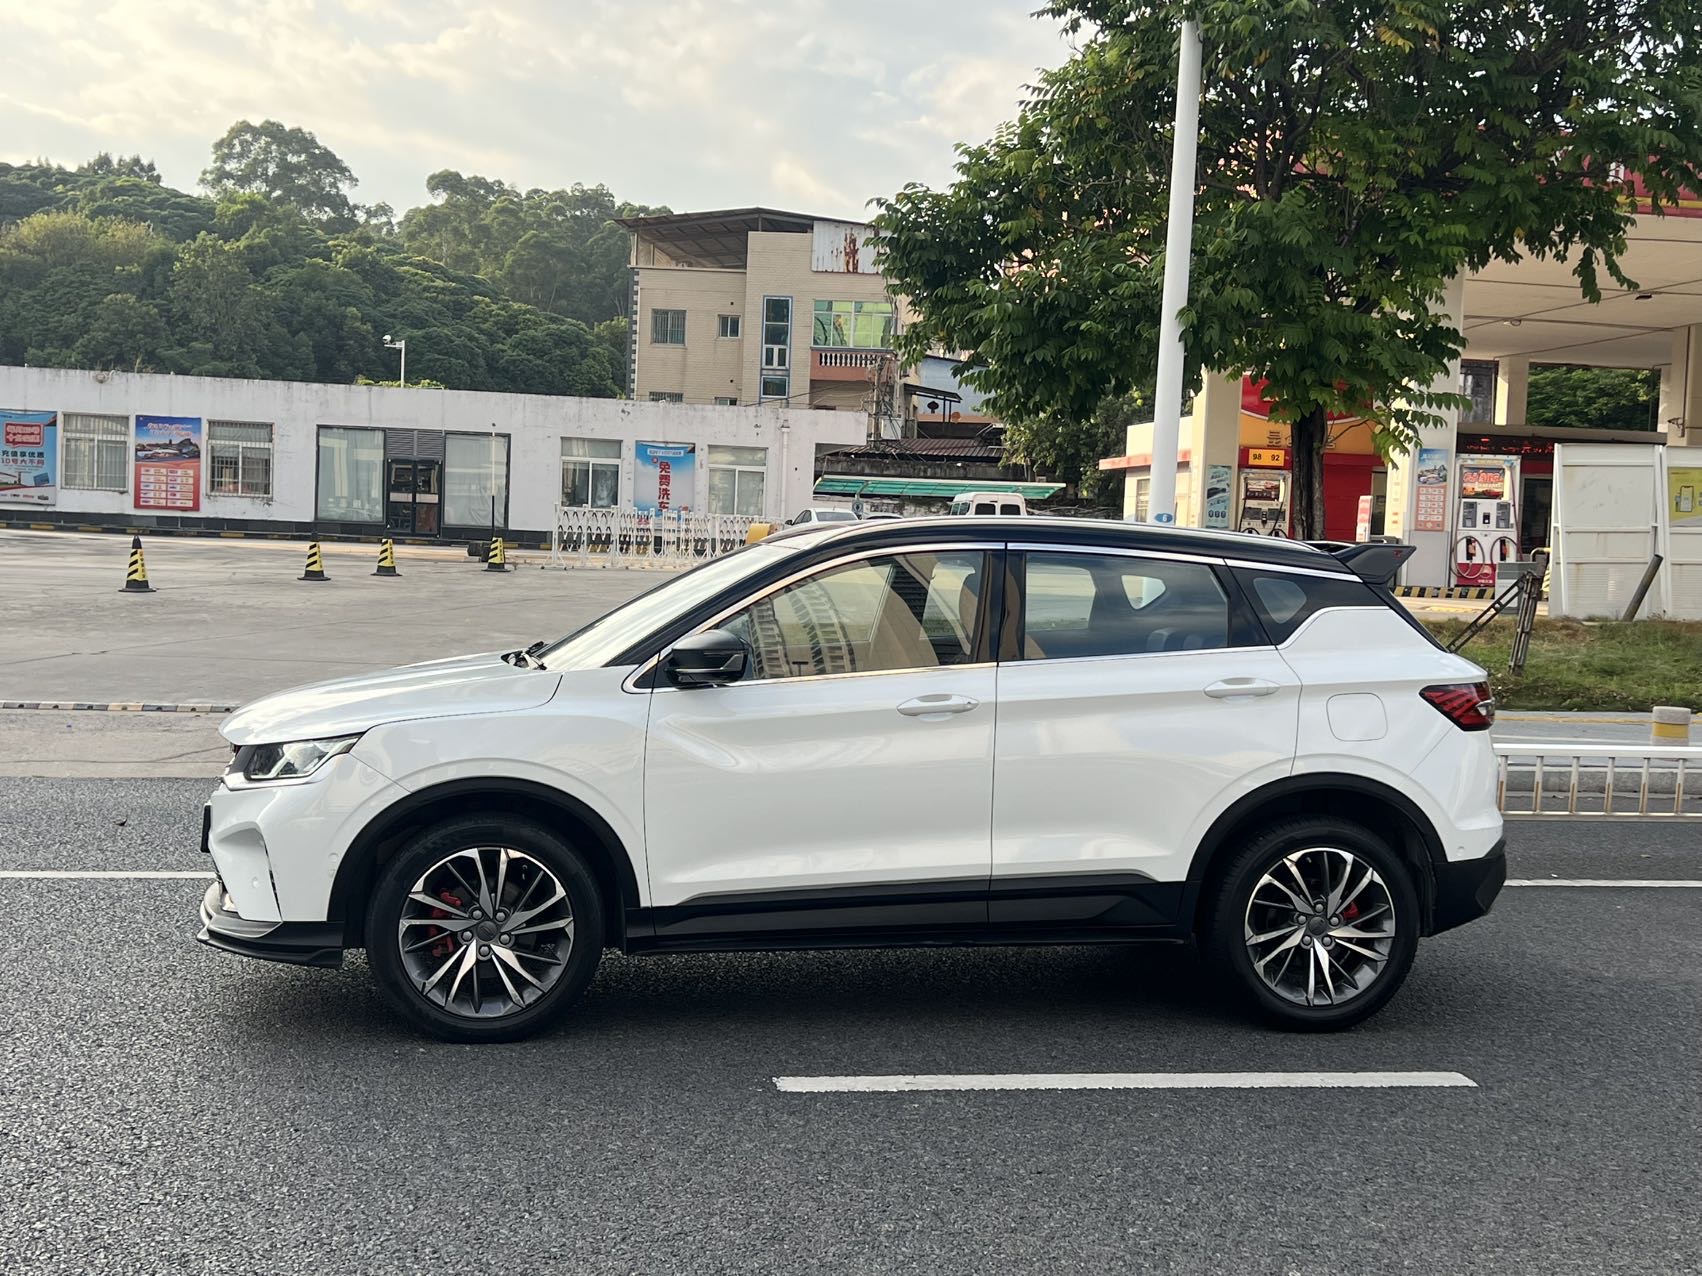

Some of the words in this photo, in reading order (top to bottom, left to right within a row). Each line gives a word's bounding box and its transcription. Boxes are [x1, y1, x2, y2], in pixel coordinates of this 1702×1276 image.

[1, 450, 45, 458] 充值享优惠
[1271, 454, 1280, 462] 92
[658, 461, 671, 512] 免费洗车
